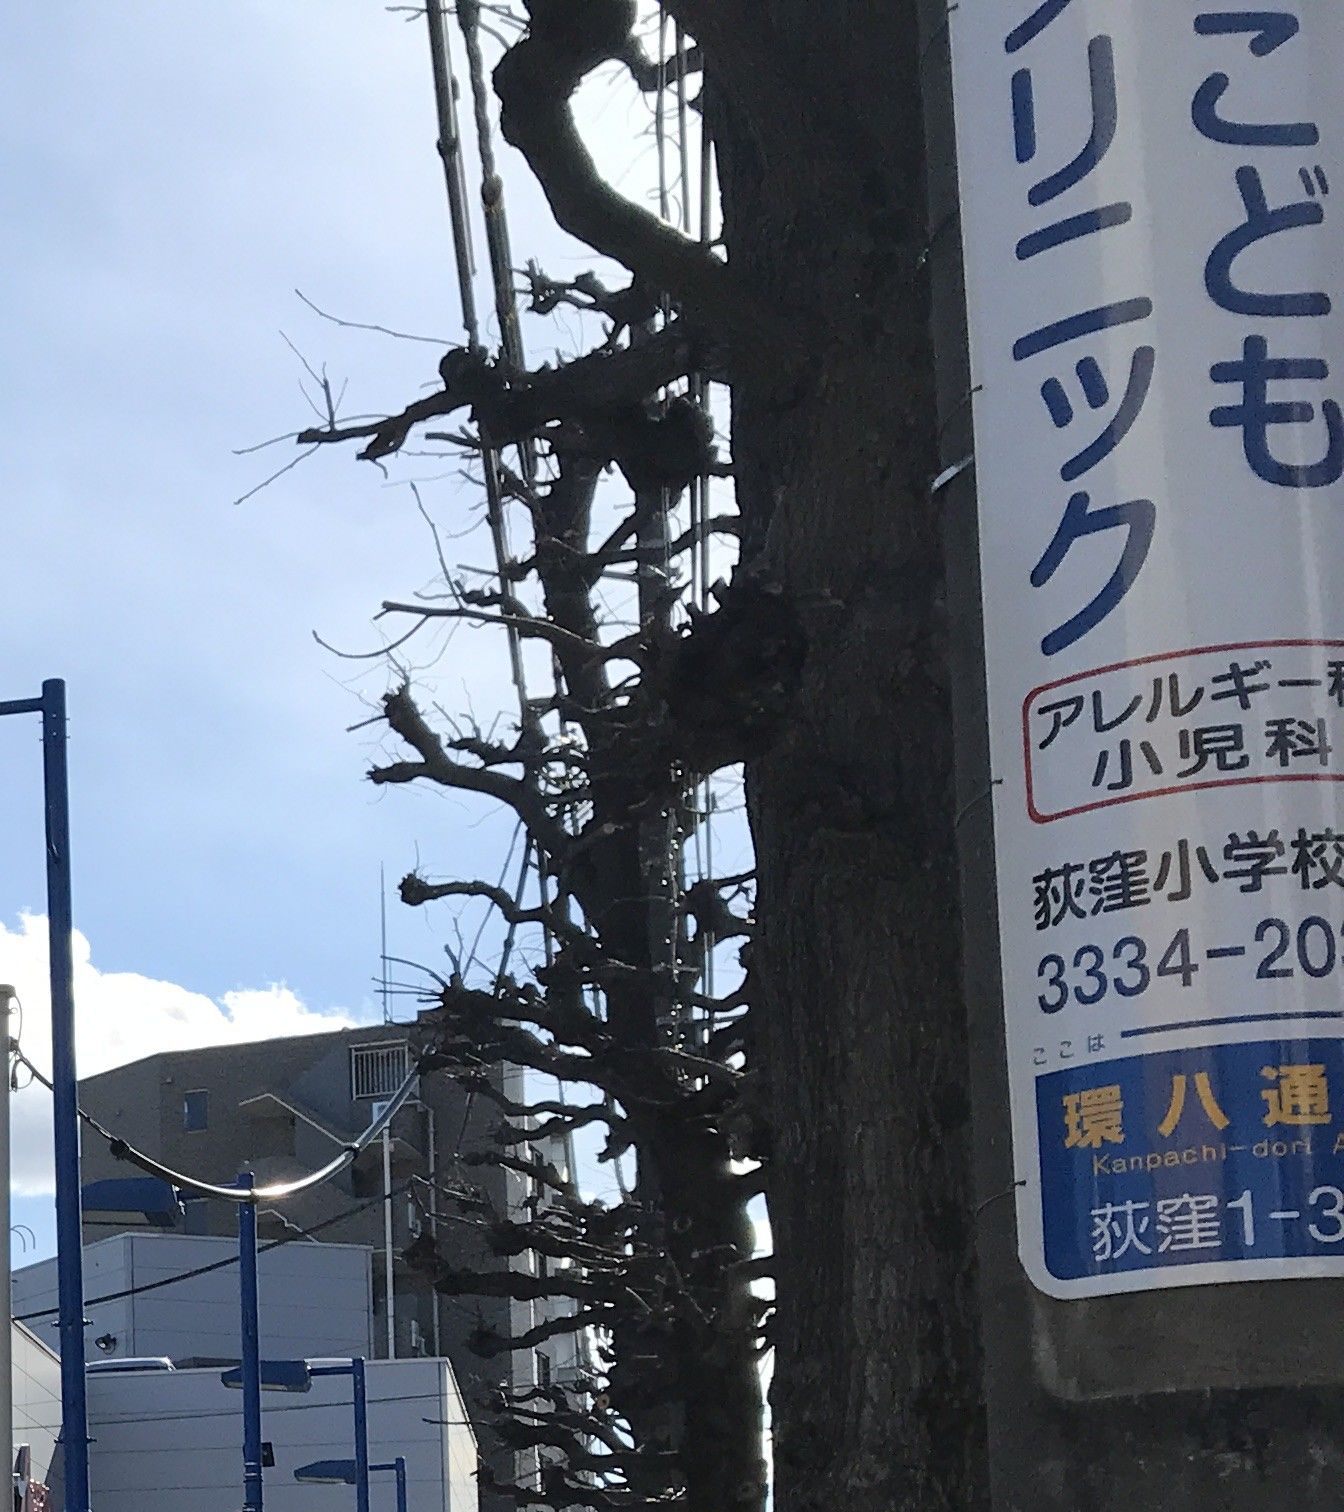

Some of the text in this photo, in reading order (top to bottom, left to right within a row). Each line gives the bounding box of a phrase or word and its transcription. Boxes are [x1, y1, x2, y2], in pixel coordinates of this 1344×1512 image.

[1191, 13, 1344, 488] こども
[1004, 0, 1156, 656] リニック
[1091, 717, 1332, 791] 小児科
[1036, 914, 1344, 1014] 3334-20
[1032, 1033, 1106, 1066] ここは
